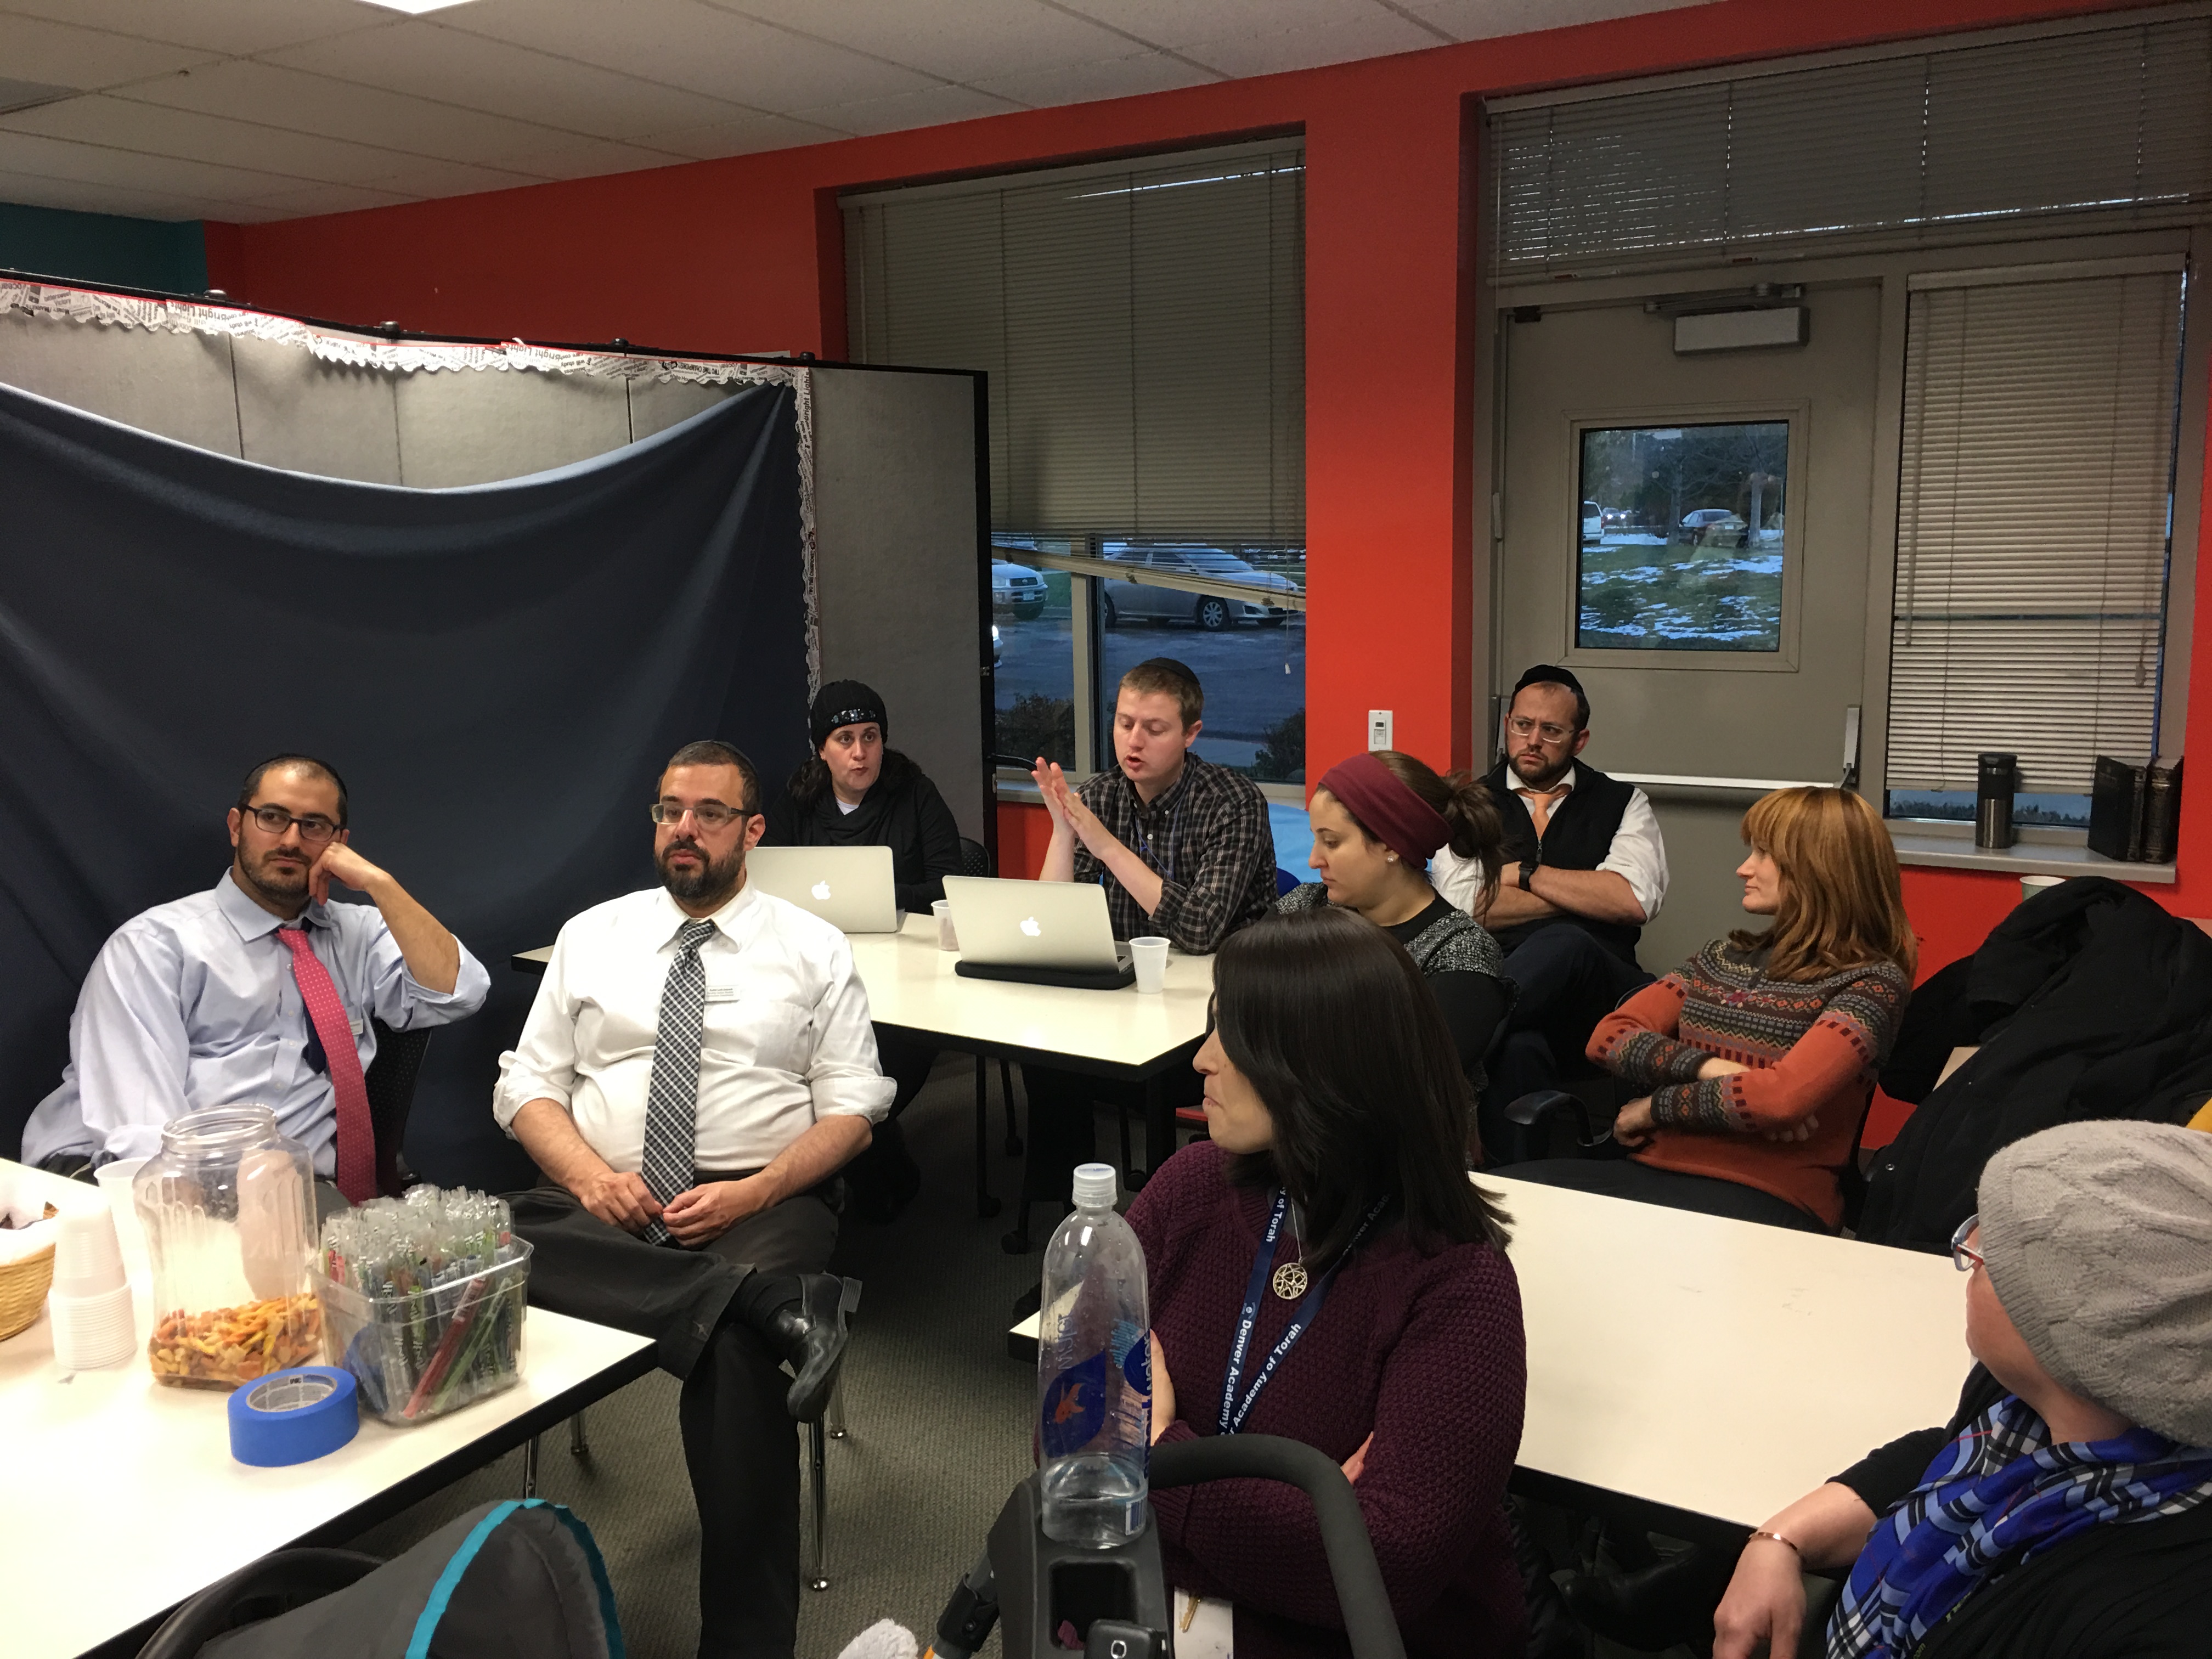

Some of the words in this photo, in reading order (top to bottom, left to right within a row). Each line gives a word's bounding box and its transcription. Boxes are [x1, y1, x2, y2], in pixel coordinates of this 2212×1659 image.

[1265, 1211, 1283, 1243] Torah
[1233, 1319, 1252, 1364] Denver
[1219, 1366, 1240, 1429] Academy
[1233, 1372, 1267, 1427] Academy
[1266, 1357, 1277, 1372] of
[1273, 1323, 1301, 1357] Torah
